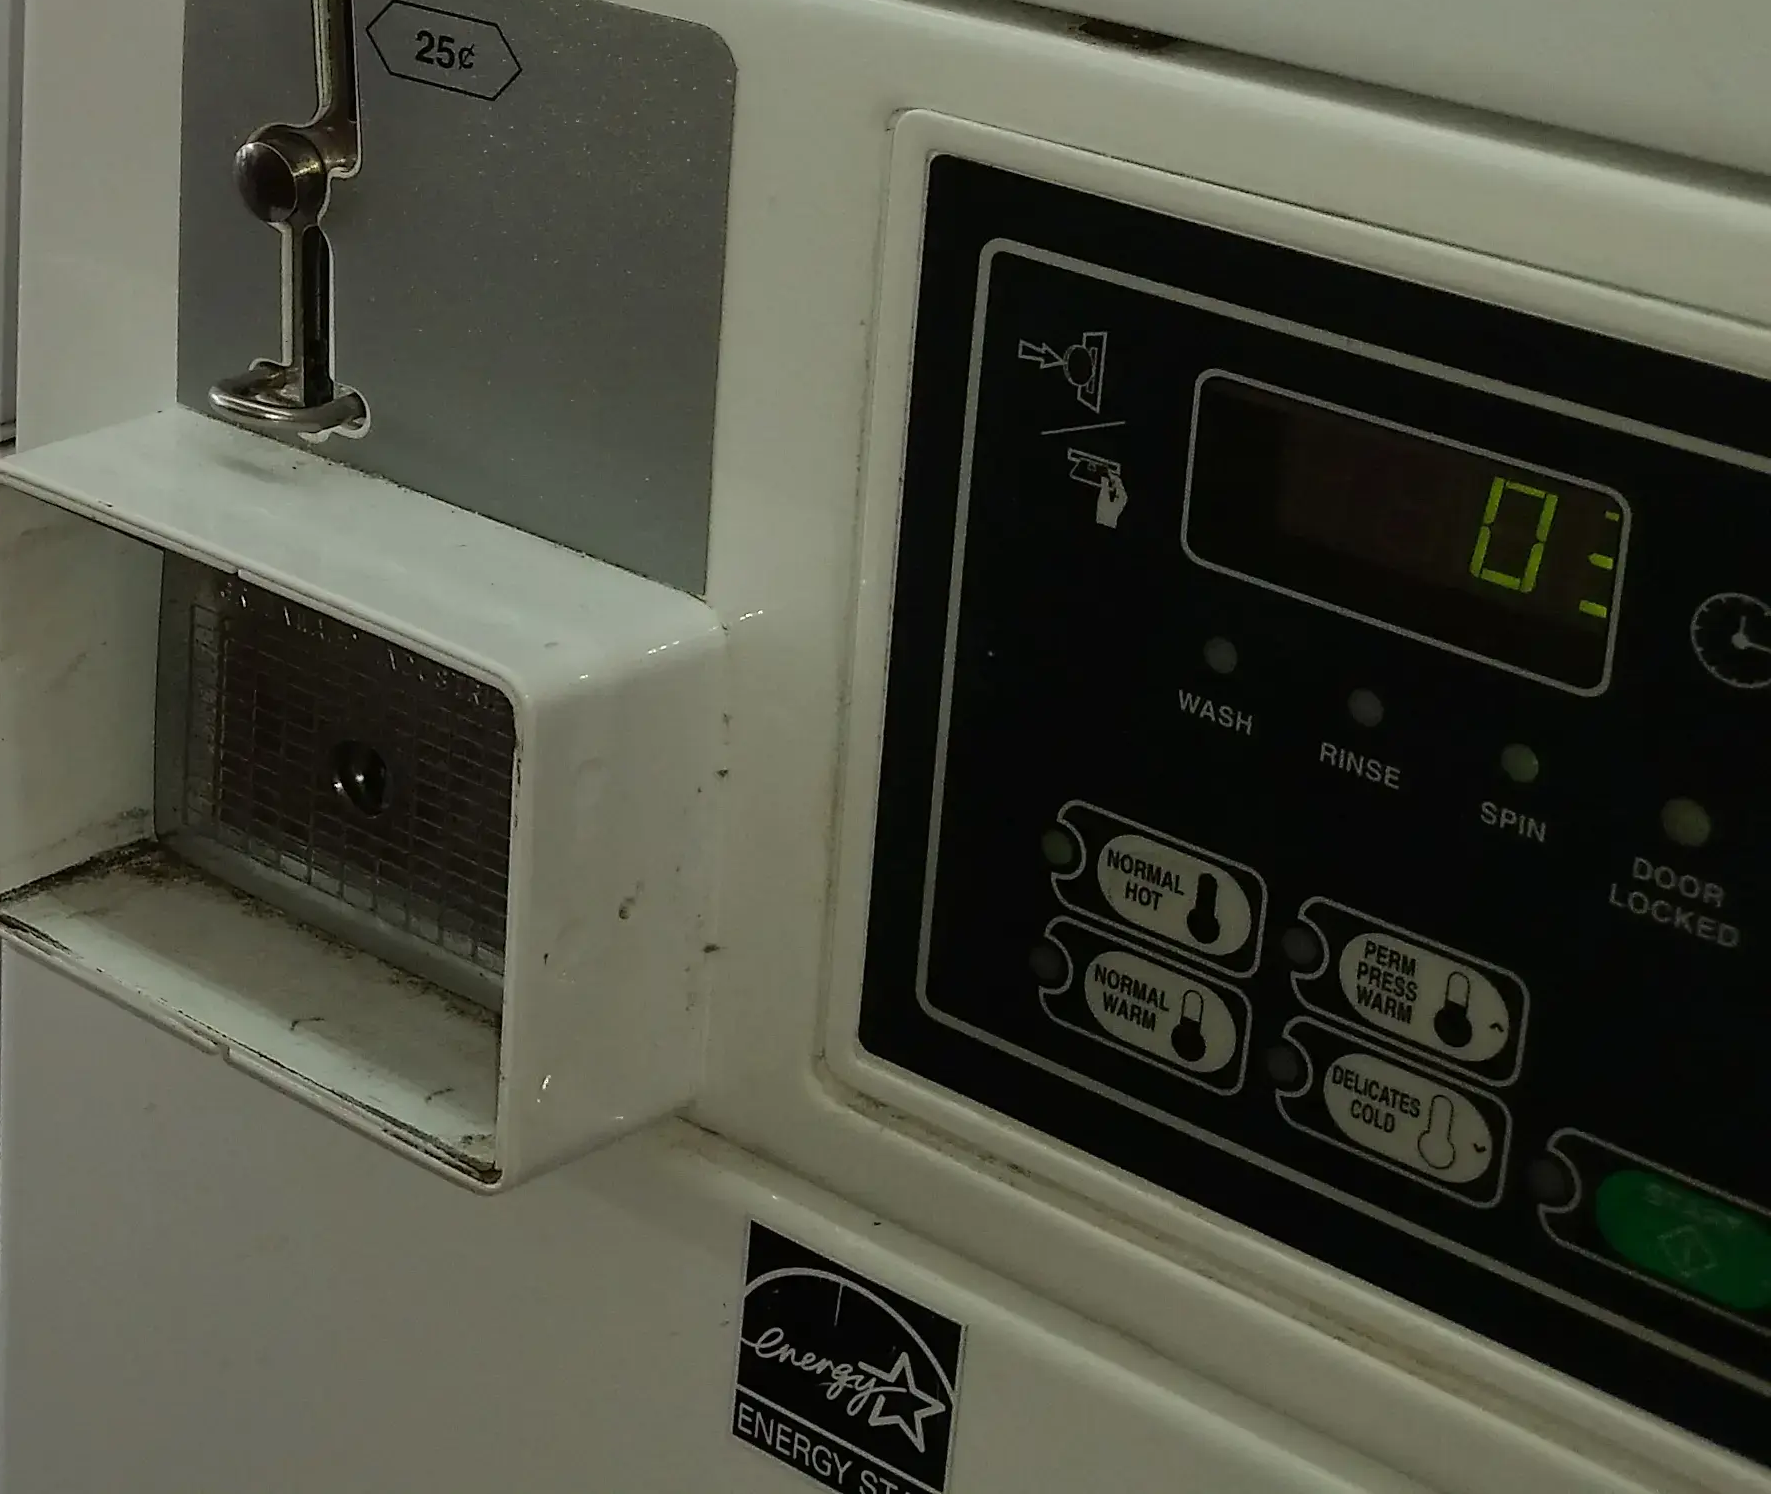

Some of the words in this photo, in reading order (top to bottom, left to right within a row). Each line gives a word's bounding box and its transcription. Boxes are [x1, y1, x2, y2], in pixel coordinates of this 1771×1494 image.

[1177, 690, 1254, 736] WASH
[1318, 741, 1401, 791] RINSE
[1479, 800, 1547, 844] SPIN
[1107, 850, 1186, 896] NORMAL
[1631, 856, 1726, 908] DOOR
[1124, 883, 1163, 911] HOT
[1608, 882, 1741, 949] LOCKED
[1363, 940, 1418, 977] PERM
[1093, 963, 1171, 1012] NORMAL
[1356, 962, 1419, 1003] PRESS
[1356, 983, 1415, 1025] WARM
[1102, 991, 1158, 1032] WARM
[1331, 1066, 1422, 1119] DELICATES
[1349, 1099, 1396, 1134] COLD
[741, 1327, 907, 1417] energy
[737, 1401, 854, 1485] ENERGY
